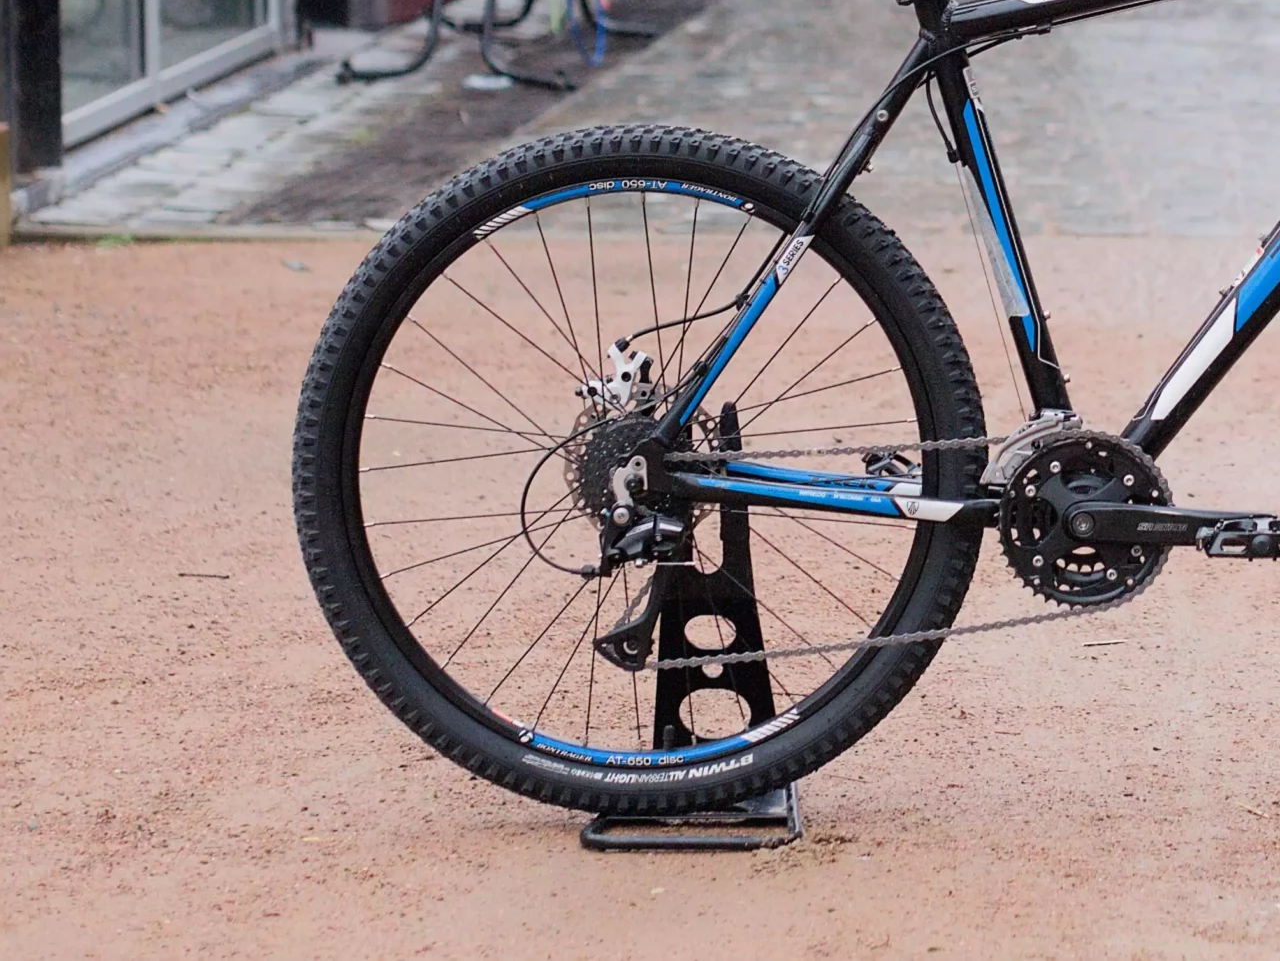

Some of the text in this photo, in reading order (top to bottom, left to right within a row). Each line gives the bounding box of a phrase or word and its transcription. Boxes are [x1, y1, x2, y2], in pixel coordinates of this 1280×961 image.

[588, 179, 738, 202] BONTRAGER AT-650 disc
[778, 239, 804, 276] 3 SERIES
[536, 742, 685, 766] BONTRAGER AT-650 disc
[688, 753, 754, 779] B'TWIN
